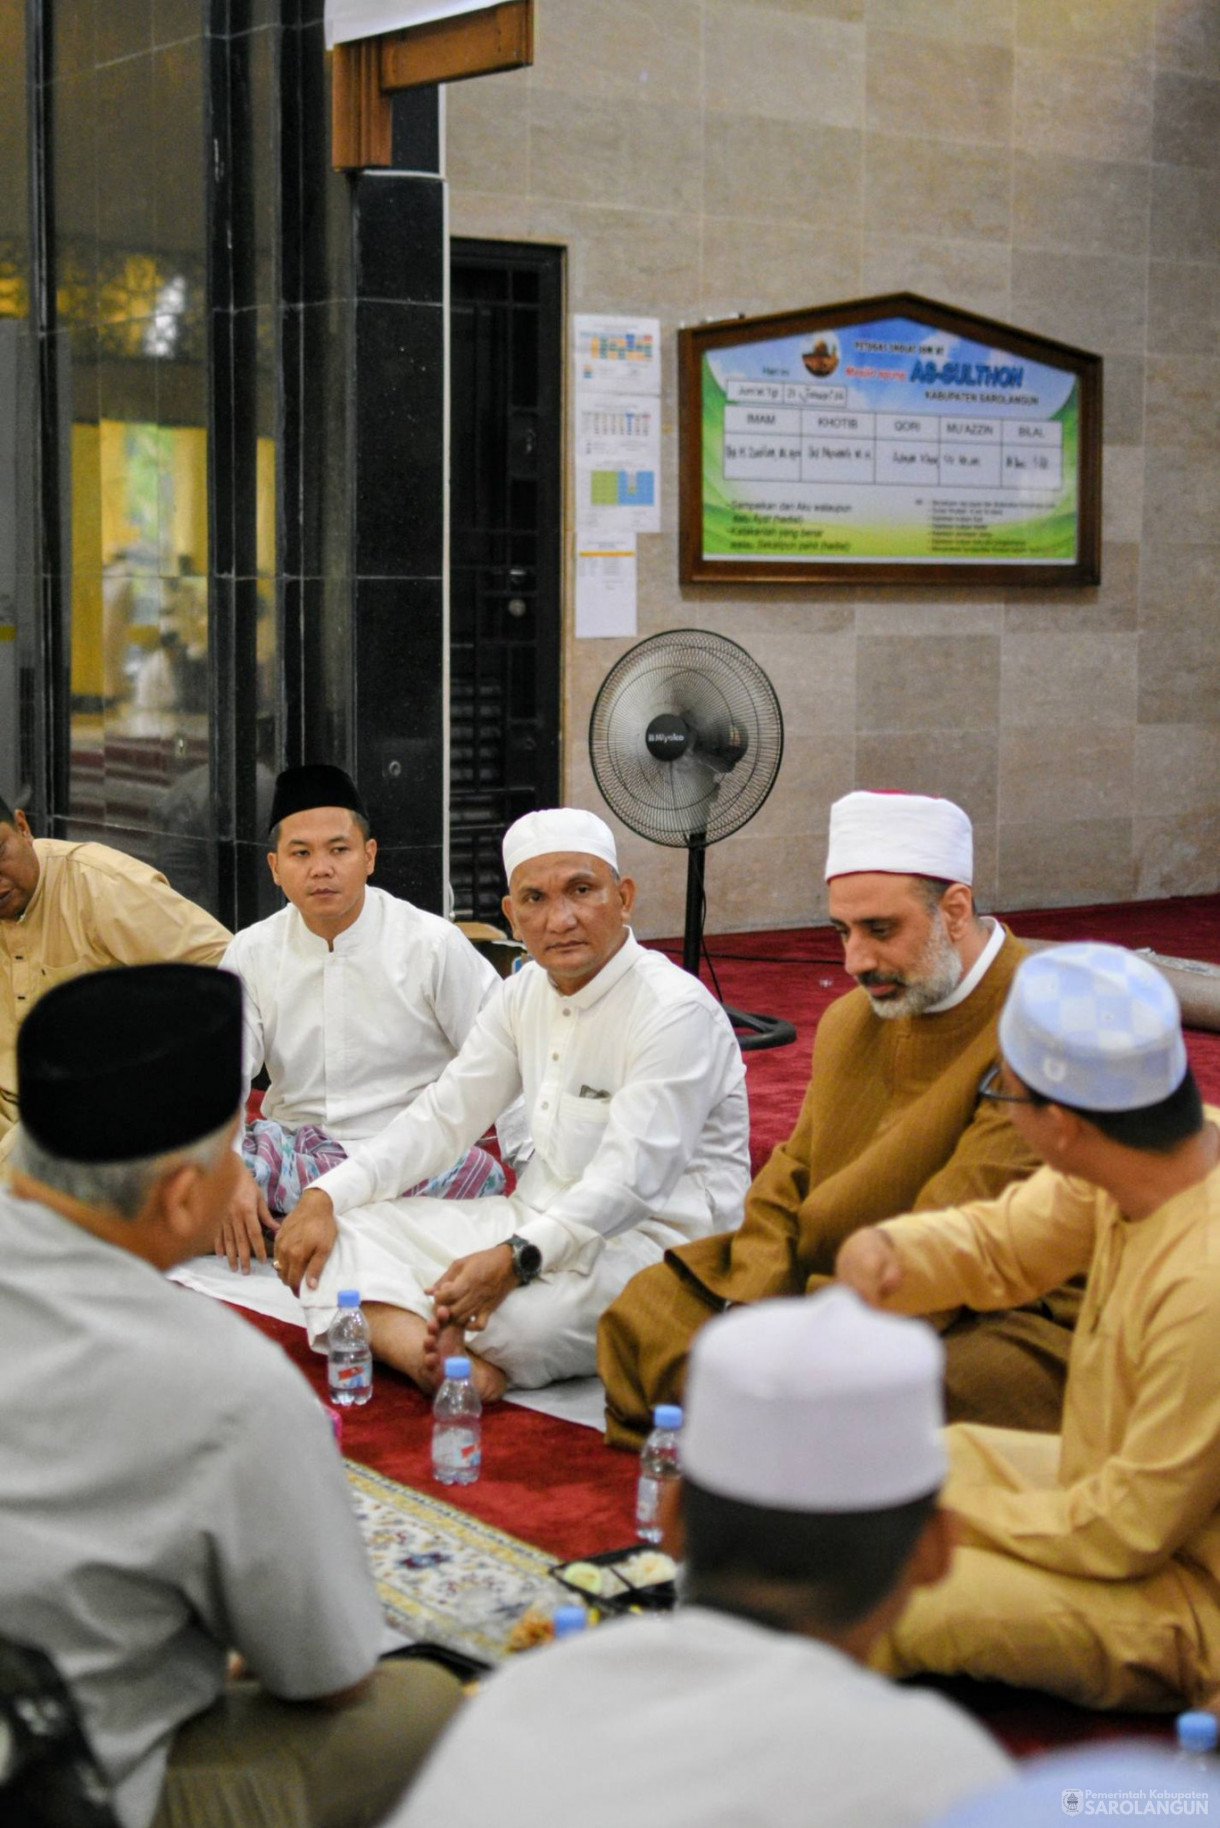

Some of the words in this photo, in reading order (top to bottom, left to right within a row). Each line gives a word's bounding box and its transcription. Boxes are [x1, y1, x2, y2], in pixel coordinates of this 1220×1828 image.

[909, 360, 1025, 389] AS-SULTHON
[747, 414, 776, 425] IMAM
[817, 417, 858, 429] KHOTIB
[655, 733, 685, 744] Miyako
